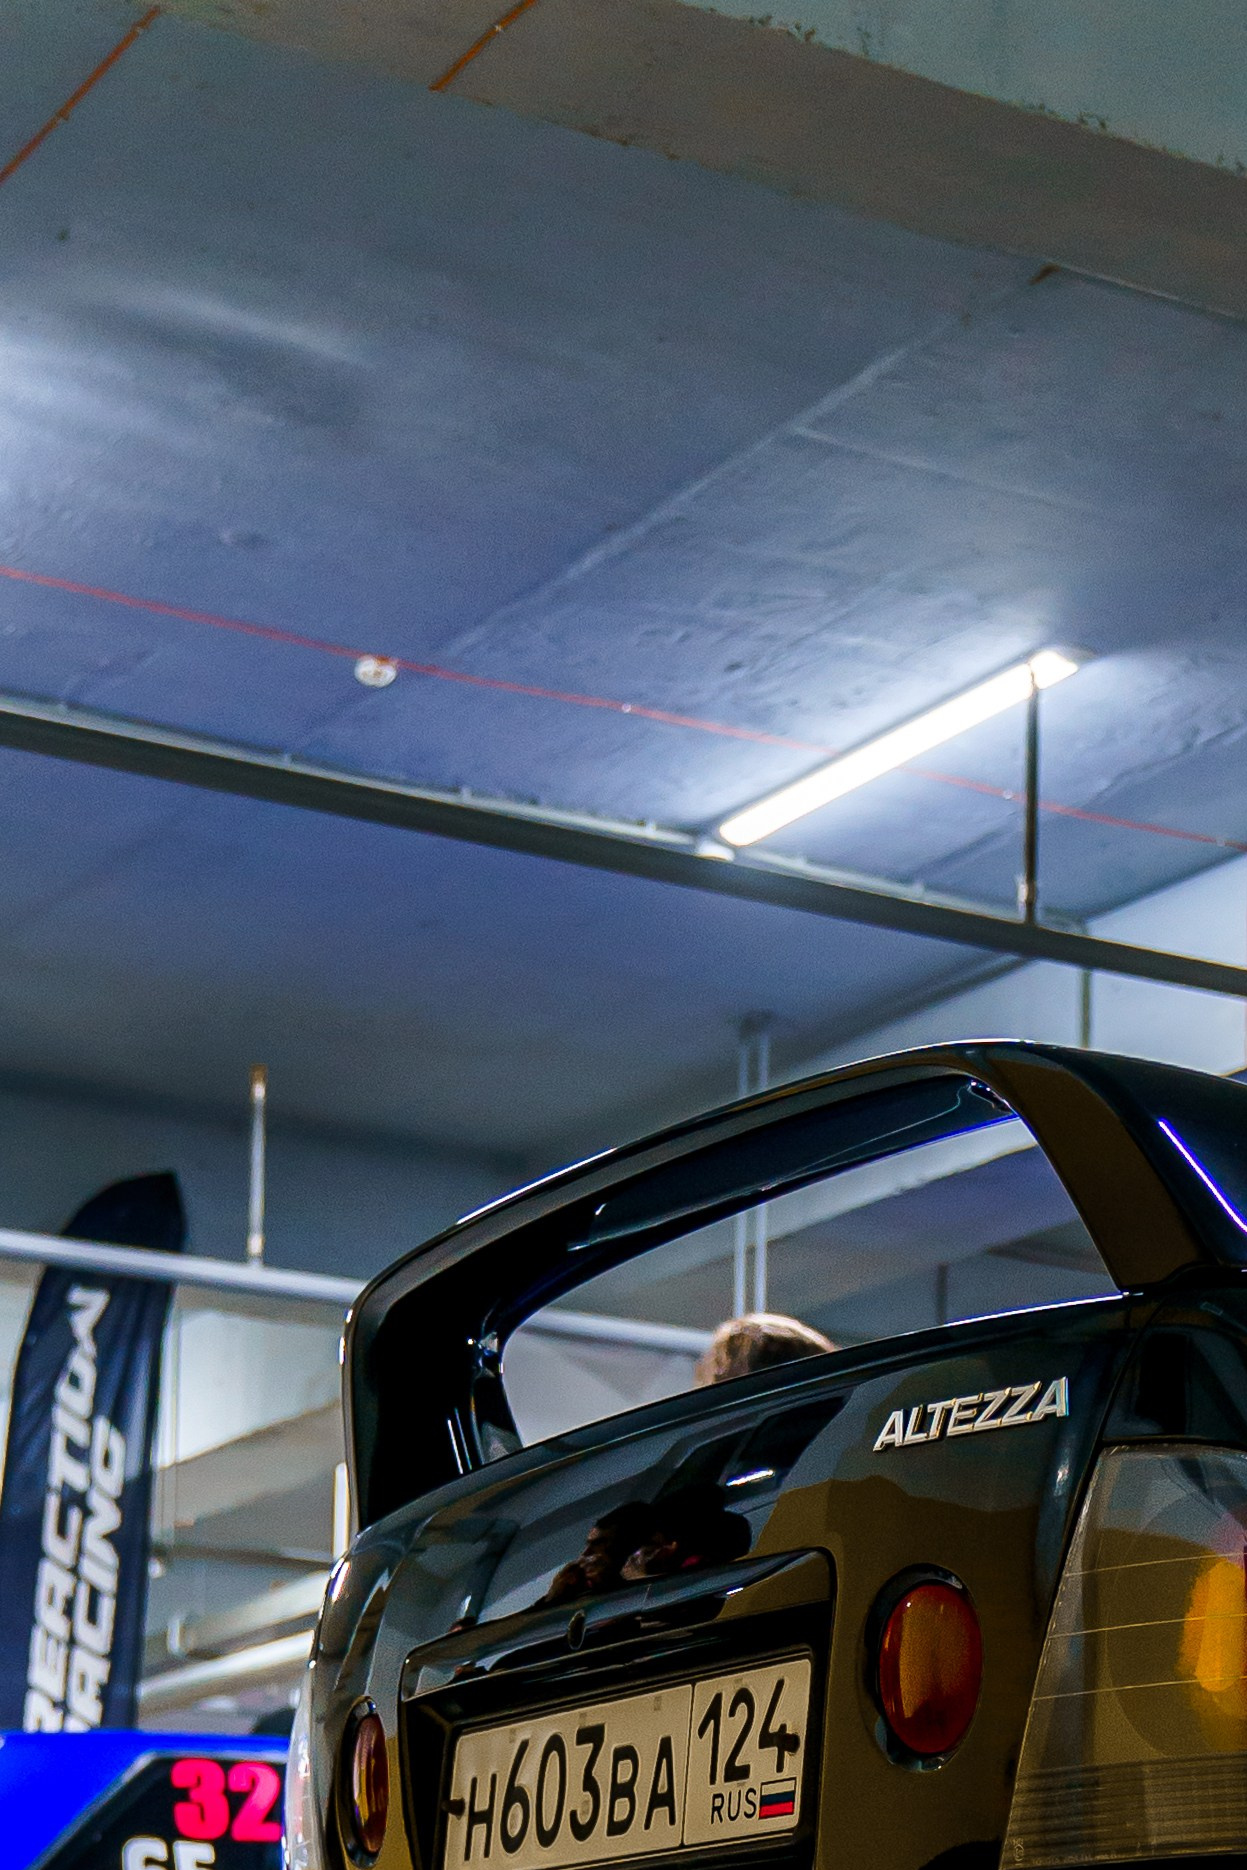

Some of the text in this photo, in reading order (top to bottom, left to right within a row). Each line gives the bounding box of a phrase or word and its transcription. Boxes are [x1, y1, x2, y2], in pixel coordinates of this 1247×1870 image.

[872, 1376, 1069, 1451] ALTEZZA
[63, 1414, 126, 1733] ACING
[697, 1677, 791, 1786] 124
[170, 1758, 282, 1843] 32
[711, 1787, 757, 1825] RUS
